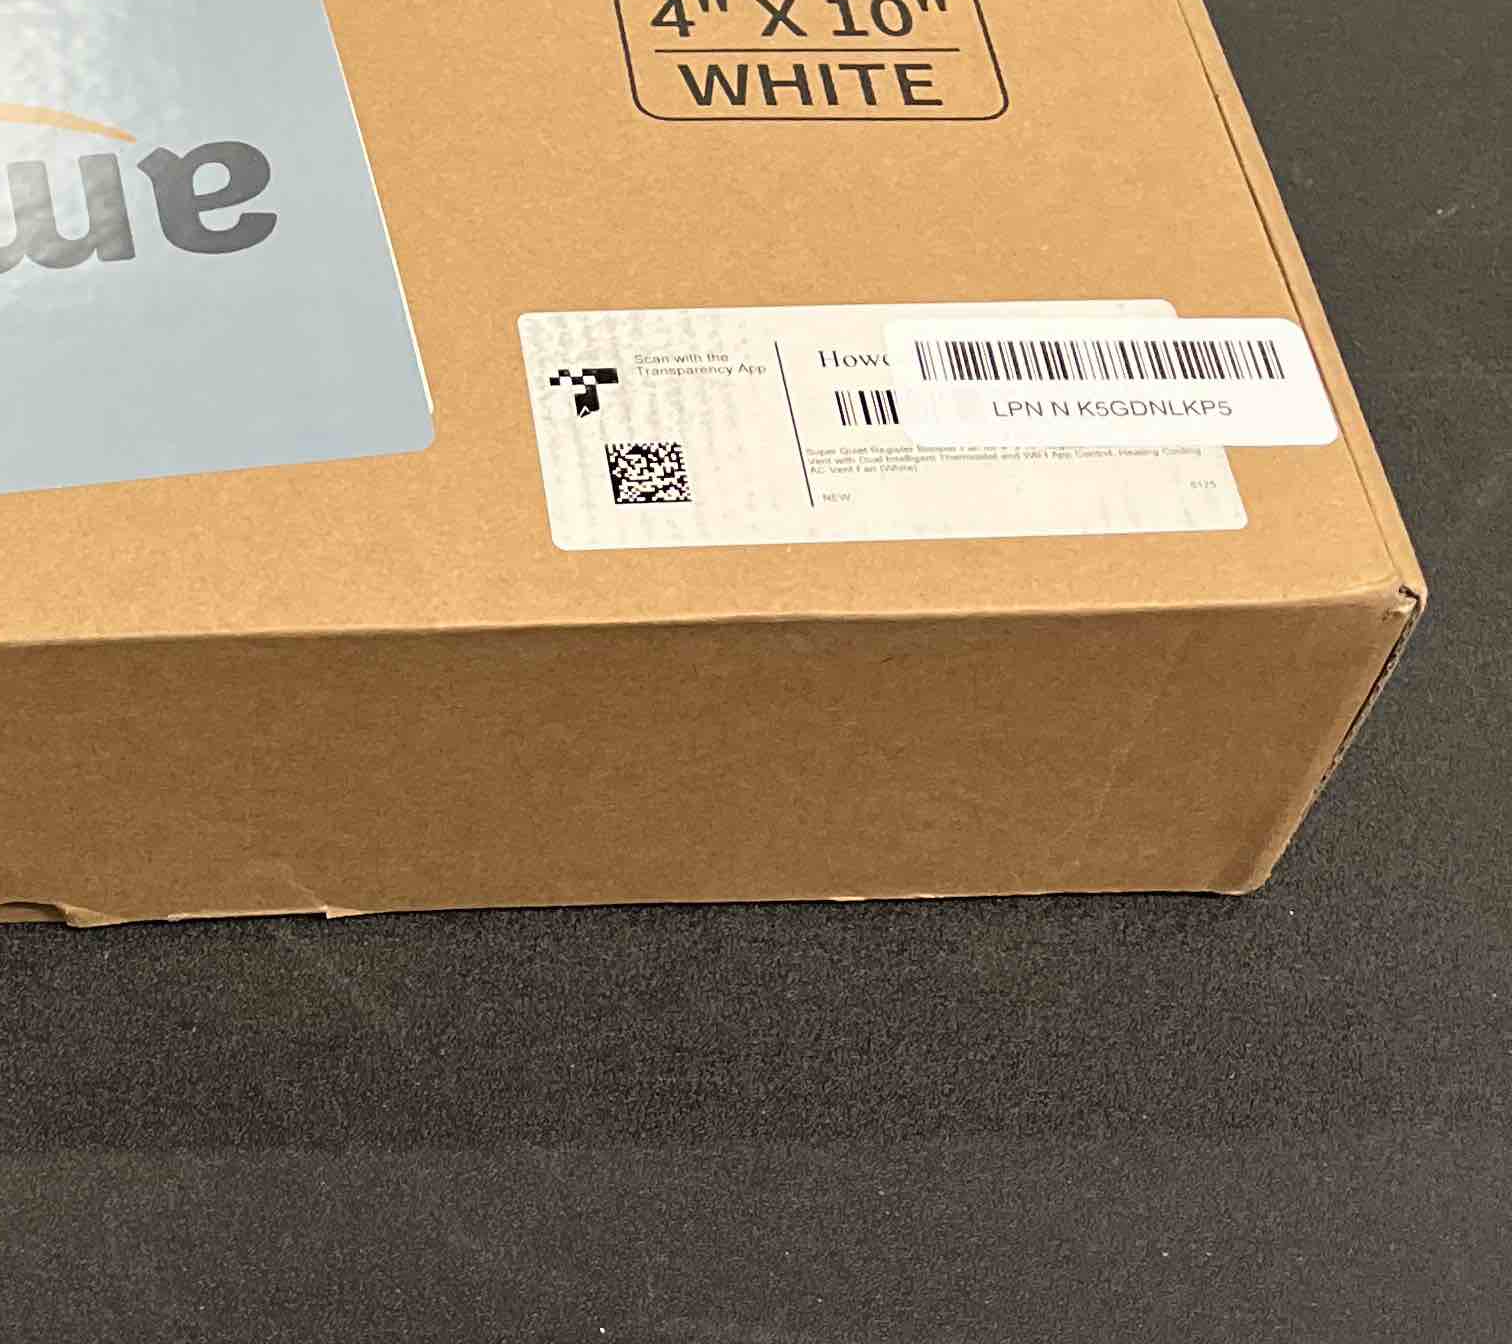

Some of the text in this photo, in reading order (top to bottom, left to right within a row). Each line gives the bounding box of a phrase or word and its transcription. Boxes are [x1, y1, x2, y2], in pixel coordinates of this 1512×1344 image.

[677, 63, 944, 106] WHITE
[634, 351, 729, 365] Scan with the
[636, 363, 767, 377] Transparency App
[992, 399, 1234, 418] LPN N K5GDNLKP5
